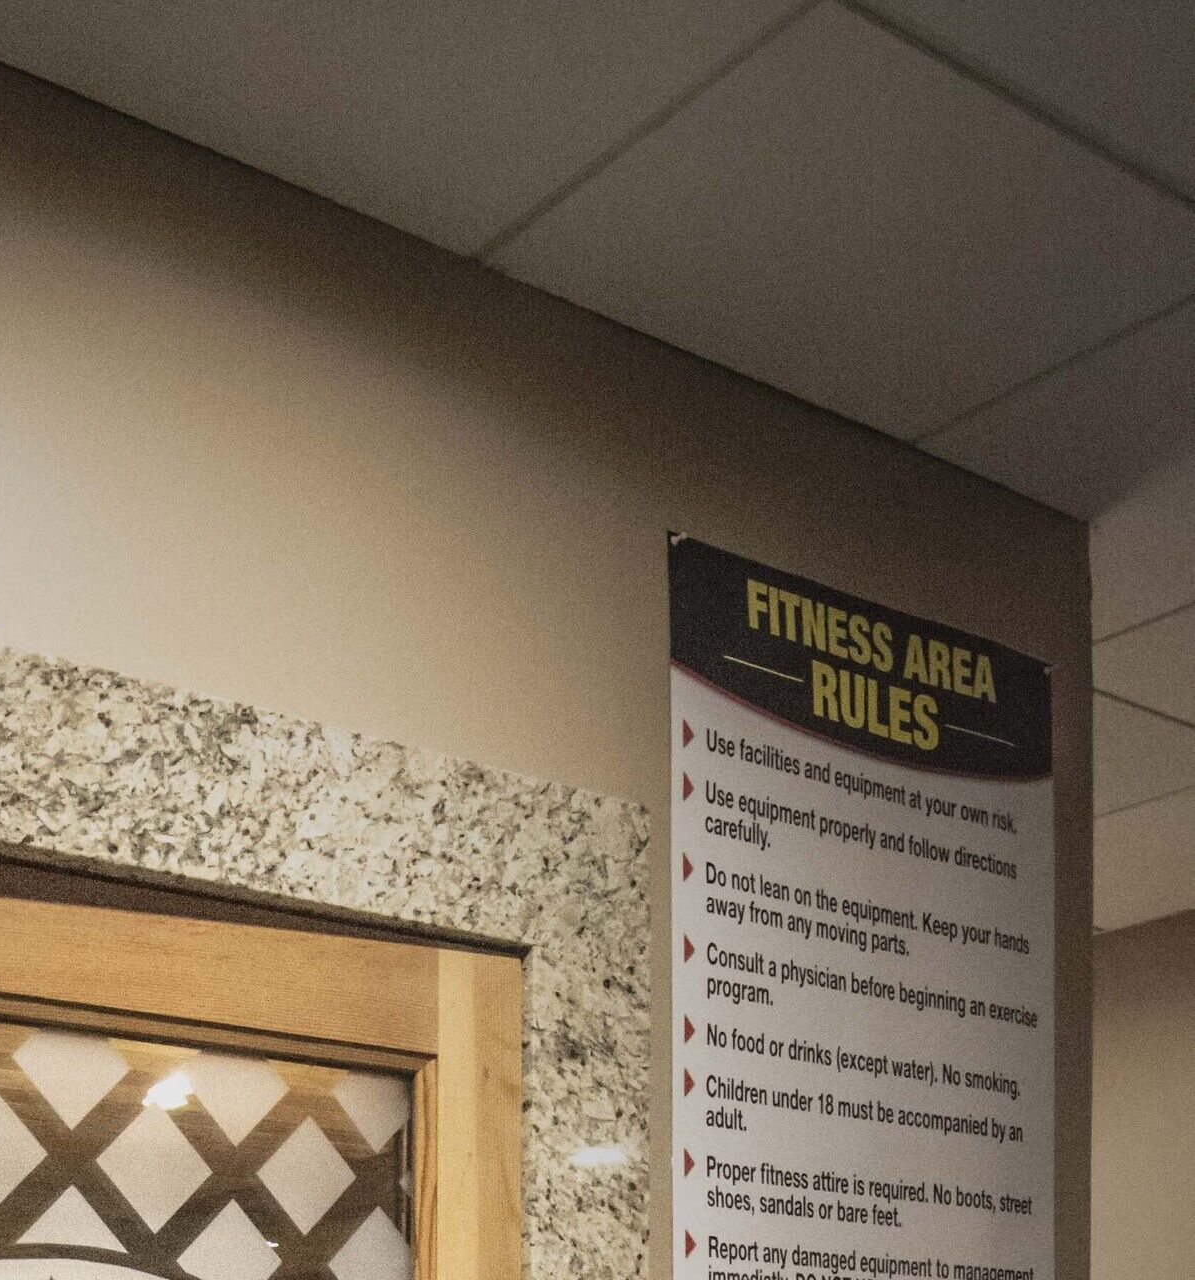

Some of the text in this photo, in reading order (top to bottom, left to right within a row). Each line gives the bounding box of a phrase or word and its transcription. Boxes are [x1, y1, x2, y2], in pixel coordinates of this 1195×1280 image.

[747, 579, 997, 703] FITNESS AREA
[812, 659, 939, 750] RULES
[706, 728, 1018, 835] Use facilities and equipment at your own risk.
[704, 815, 771, 852] carefully.
[705, 779, 1018, 880] Use equipment properly and follow directions
[705, 861, 1030, 955] Do not lean on the equipment. Keep your hands
[706, 896, 910, 957] away from any moving parts.
[706, 941, 1039, 1029] Consult a physician before beginning an exercise
[706, 977, 774, 1006] program.
[706, 1022, 1021, 1101] No food or drinks (except water). No smoking.
[705, 1074, 1024, 1144] Children under 18 must be accompanied by an
[705, 1106, 747, 1132] adult.
[706, 1154, 1033, 1216] Proper fitness attire is required. No boots, street
[707, 1185, 902, 1228] shoes, sandals or bare feet.
[708, 1235, 759, 1265] Report
[762, 1246, 788, 1270] any
[791, 1244, 857, 1275] damaged
[859, 1253, 933, 1279] equipment
[935, 1259, 950, 1280] to
